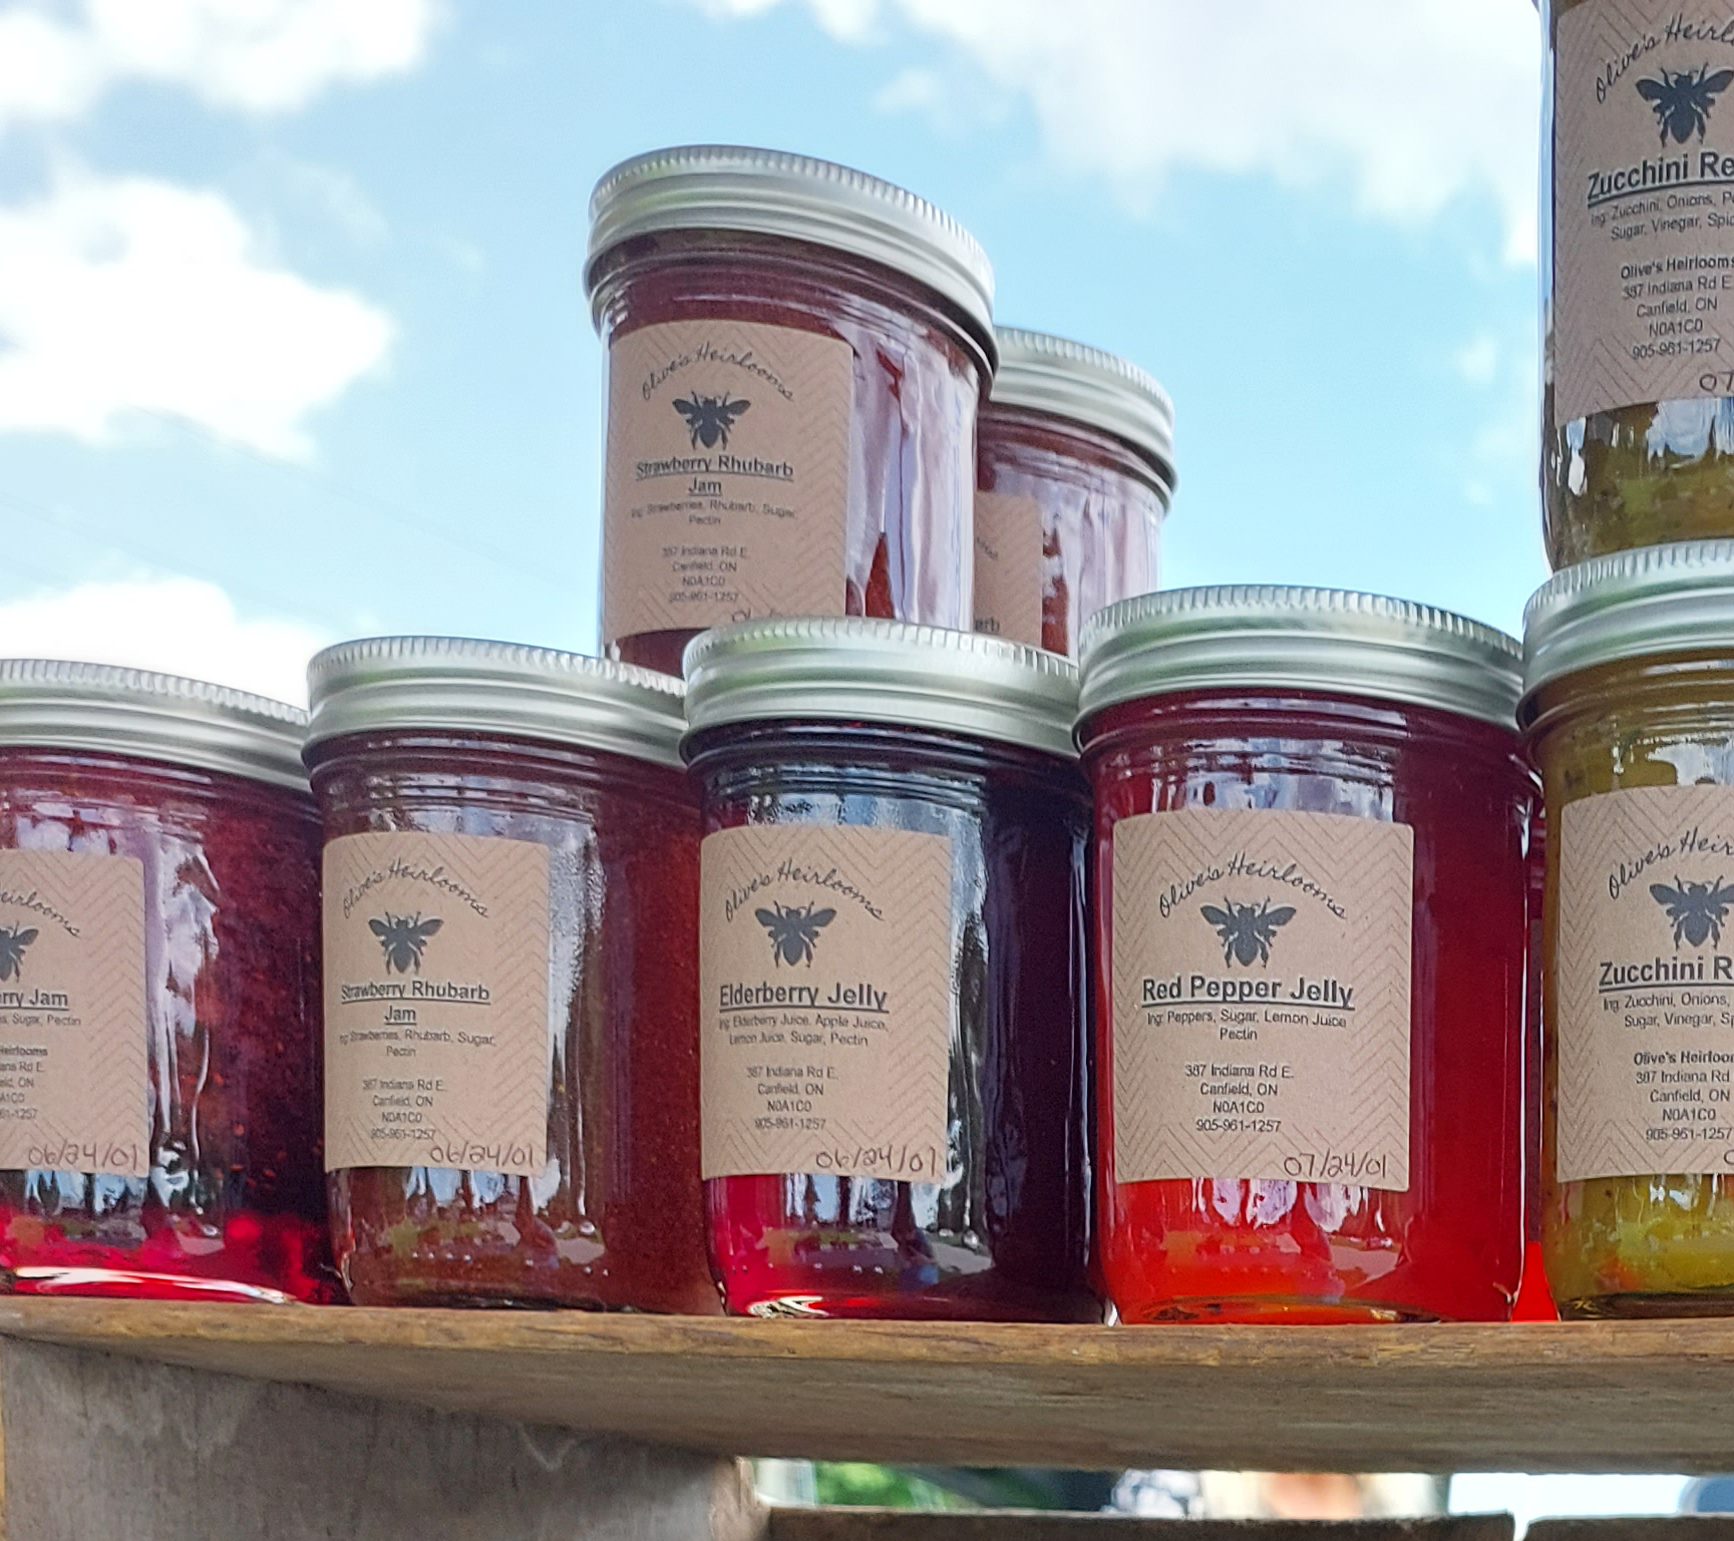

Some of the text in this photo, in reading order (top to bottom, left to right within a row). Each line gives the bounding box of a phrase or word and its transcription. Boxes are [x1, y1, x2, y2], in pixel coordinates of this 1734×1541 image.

[1589, 154, 1688, 199] Zucchini
[696, 341, 794, 401] Heirlooms
[636, 455, 793, 476] Strawberry Rhubarb
[689, 478, 722, 493] Jam
[389, 858, 489, 918] Heirlooms
[777, 858, 884, 921] Heirlooms
[1227, 851, 1347, 920] Heirlooms
[0, 891, 80, 938] eirlooms
[1600, 957, 1704, 986] Zucchini
[29, 989, 68, 1005] Jam
[342, 981, 489, 1000] Strawberry Rhubarb
[720, 982, 887, 1008] Elderberry Jelly
[1143, 976, 1354, 1008] Red Pepper Jelly
[1681, 992, 1730, 1007] Onions,
[385, 1006, 416, 1021] Jam
[816, 1015, 848, 1029] Apple
[1264, 1011, 1309, 1025] Lemon
[830, 1033, 868, 1046] Pectin
[1220, 1028, 1258, 1040] Pectin
[1211, 1065, 1277, 1077] Indiana Rd
[1661, 1070, 1730, 1083] Indiana Rd
[1257, 1084, 1277, 1095] ON
[1709, 1090, 1730, 1102] ON
[1284, 1149, 1386, 1179] 07/24/01
